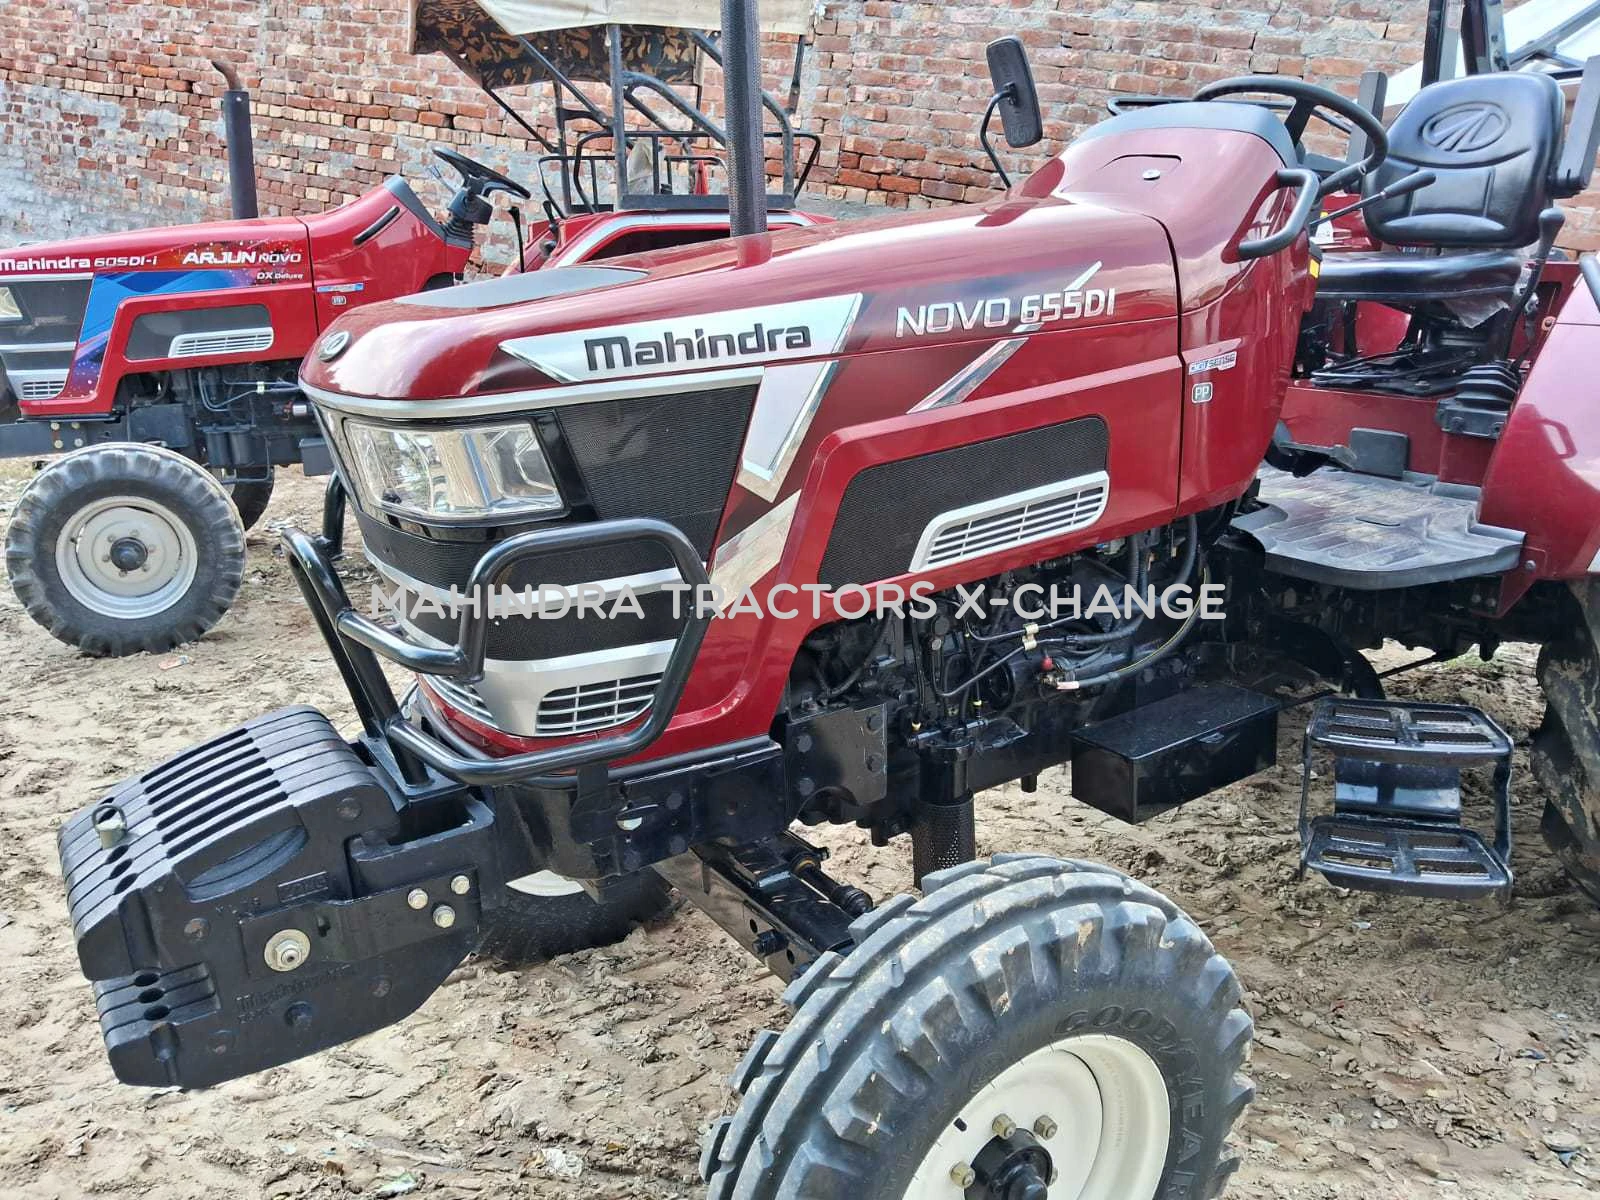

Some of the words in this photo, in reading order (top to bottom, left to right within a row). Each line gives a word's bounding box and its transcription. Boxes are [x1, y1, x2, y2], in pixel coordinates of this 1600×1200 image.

[0, 256, 91, 271] Mahindra
[182, 251, 257, 264] ARJUN
[256, 271, 274, 280] DX
[895, 298, 1011, 338] NOVO
[1020, 287, 1116, 324] 655DI
[583, 323, 812, 371] Mahindra
